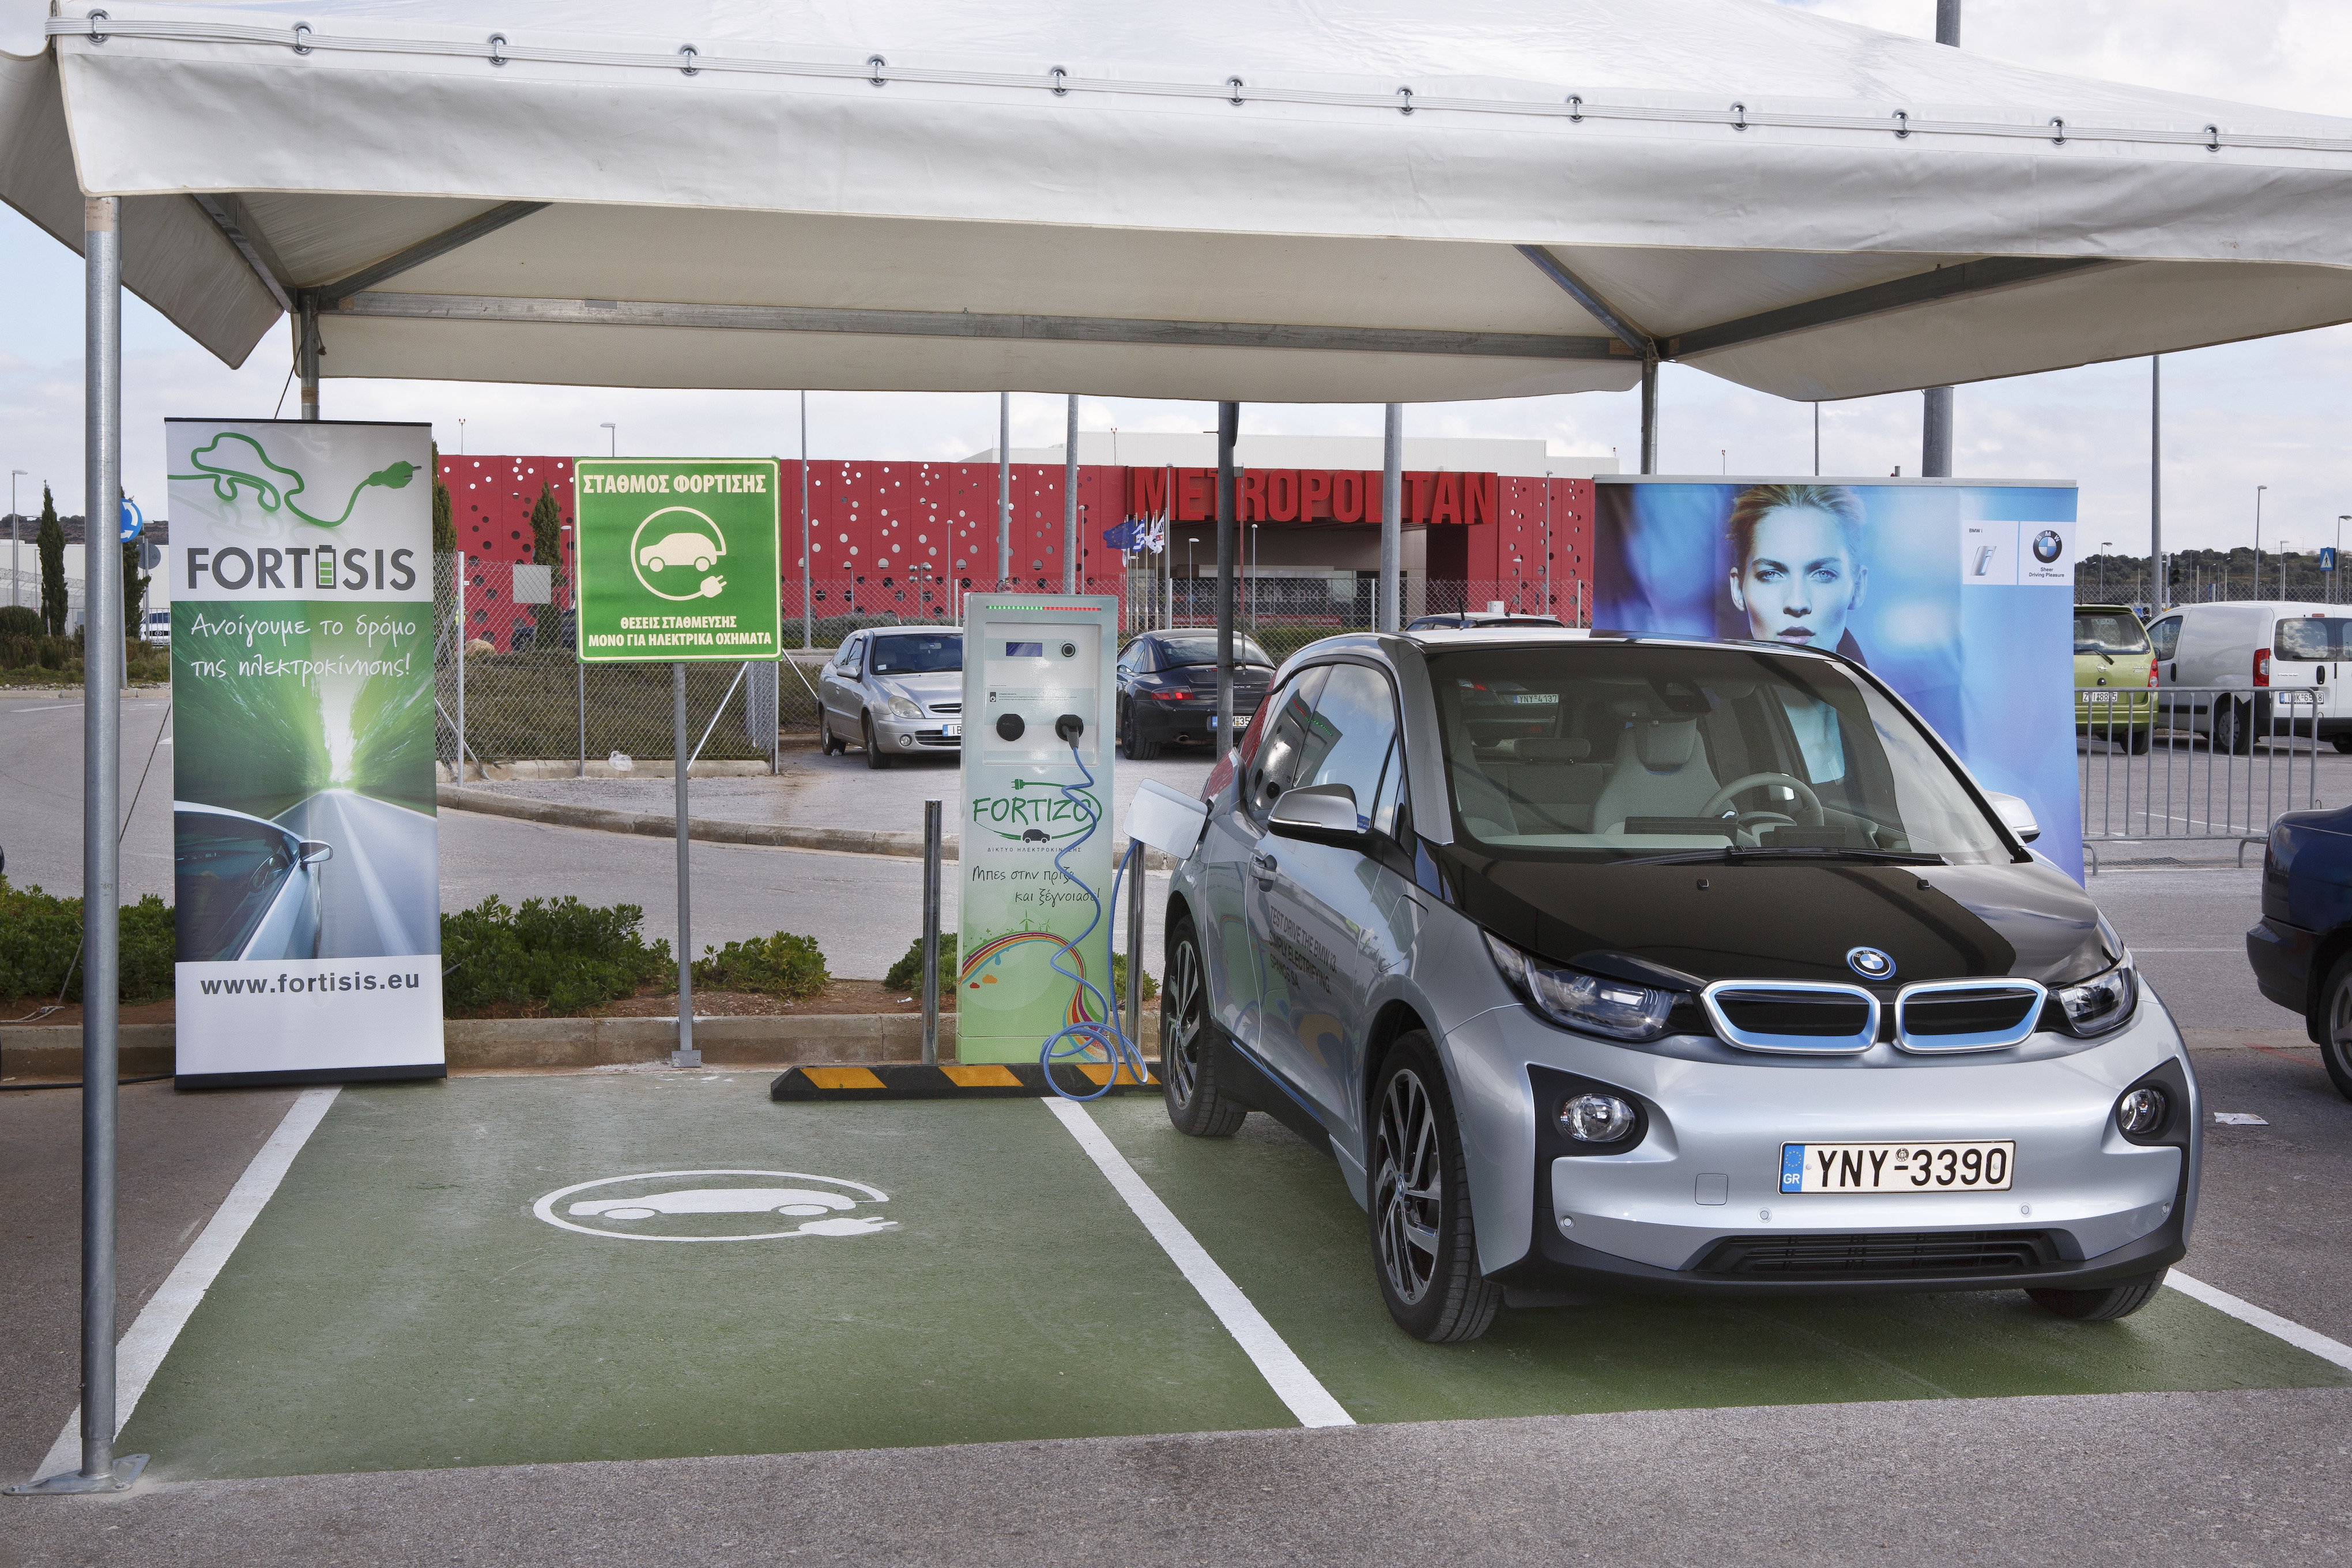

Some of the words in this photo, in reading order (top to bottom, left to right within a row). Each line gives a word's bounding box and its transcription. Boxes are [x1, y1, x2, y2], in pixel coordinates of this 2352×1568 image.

[583, 474, 670, 493] ΣΤΑΘΜΟΣ
[673, 474, 767, 493] ΦΟΡΤΙΣΗΣ
[1134, 467, 1495, 525] MEROPOLTAN
[2036, 531, 2060, 542] BMW
[190, 613, 311, 648] Ανοίγουμε
[320, 619, 344, 636] το
[356, 613, 416, 648] δρόμο
[620, 616, 661, 630] ΘΕΣΕΙΣ
[662, 616, 737, 630] ΣΤΑΘΜΕΥΣΗΣ
[588, 634, 624, 647] ΜΟΝΟ
[627, 634, 646, 647] ΓΙΑ
[648, 633, 714, 646] ΗΛΕΚΤΡΙΚΑ
[715, 632, 772, 645] ΟΧΗΜΑΤΑ
[191, 661, 227, 678] της
[239, 653, 410, 687] ηλεκτροκίνησης!
[1519, 695, 1558, 703] YNY-4137
[973, 796, 1091, 826] FORTIZO
[973, 865, 1006, 881] Μπες
[1011, 870, 1039, 880] στην
[1015, 891, 1033, 903] και
[1270, 905, 1284, 930] TEST
[1283, 916, 1301, 944] DRIVE
[1302, 929, 1314, 954] THE
[1314, 939, 1330, 966] BMW
[1269, 929, 1288, 958] SIMPLY
[1288, 945, 1332, 996] ELECTRIFYING.
[1854, 950, 1883, 958] BMW
[200, 972, 420, 996] www.fortisis.eu
[1817, 1148, 2007, 1188] YNY-3390
[1783, 1173, 1801, 1185] GR
